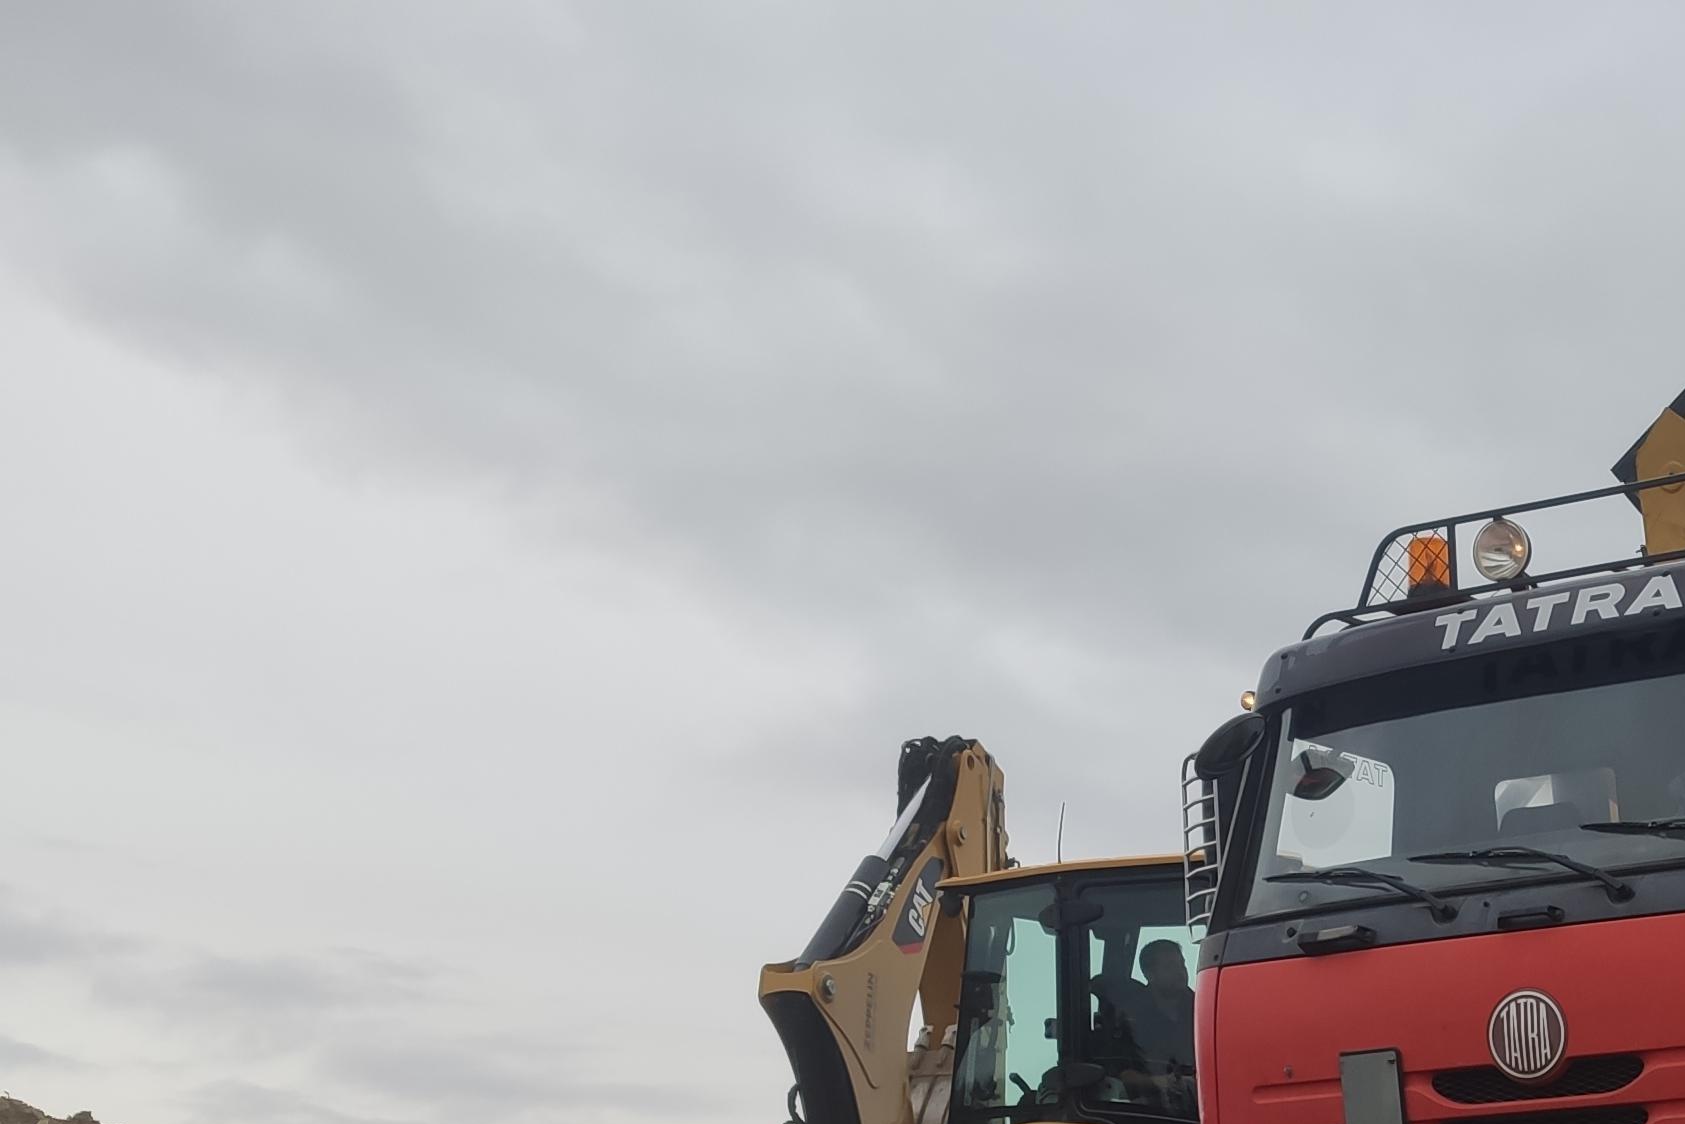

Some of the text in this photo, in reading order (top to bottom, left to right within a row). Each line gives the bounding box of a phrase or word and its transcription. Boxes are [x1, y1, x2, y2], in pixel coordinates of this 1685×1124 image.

[1434, 574, 1683, 651] TATRA
[908, 877, 933, 937] CAT
[1500, 997, 1551, 1072] TATRA
